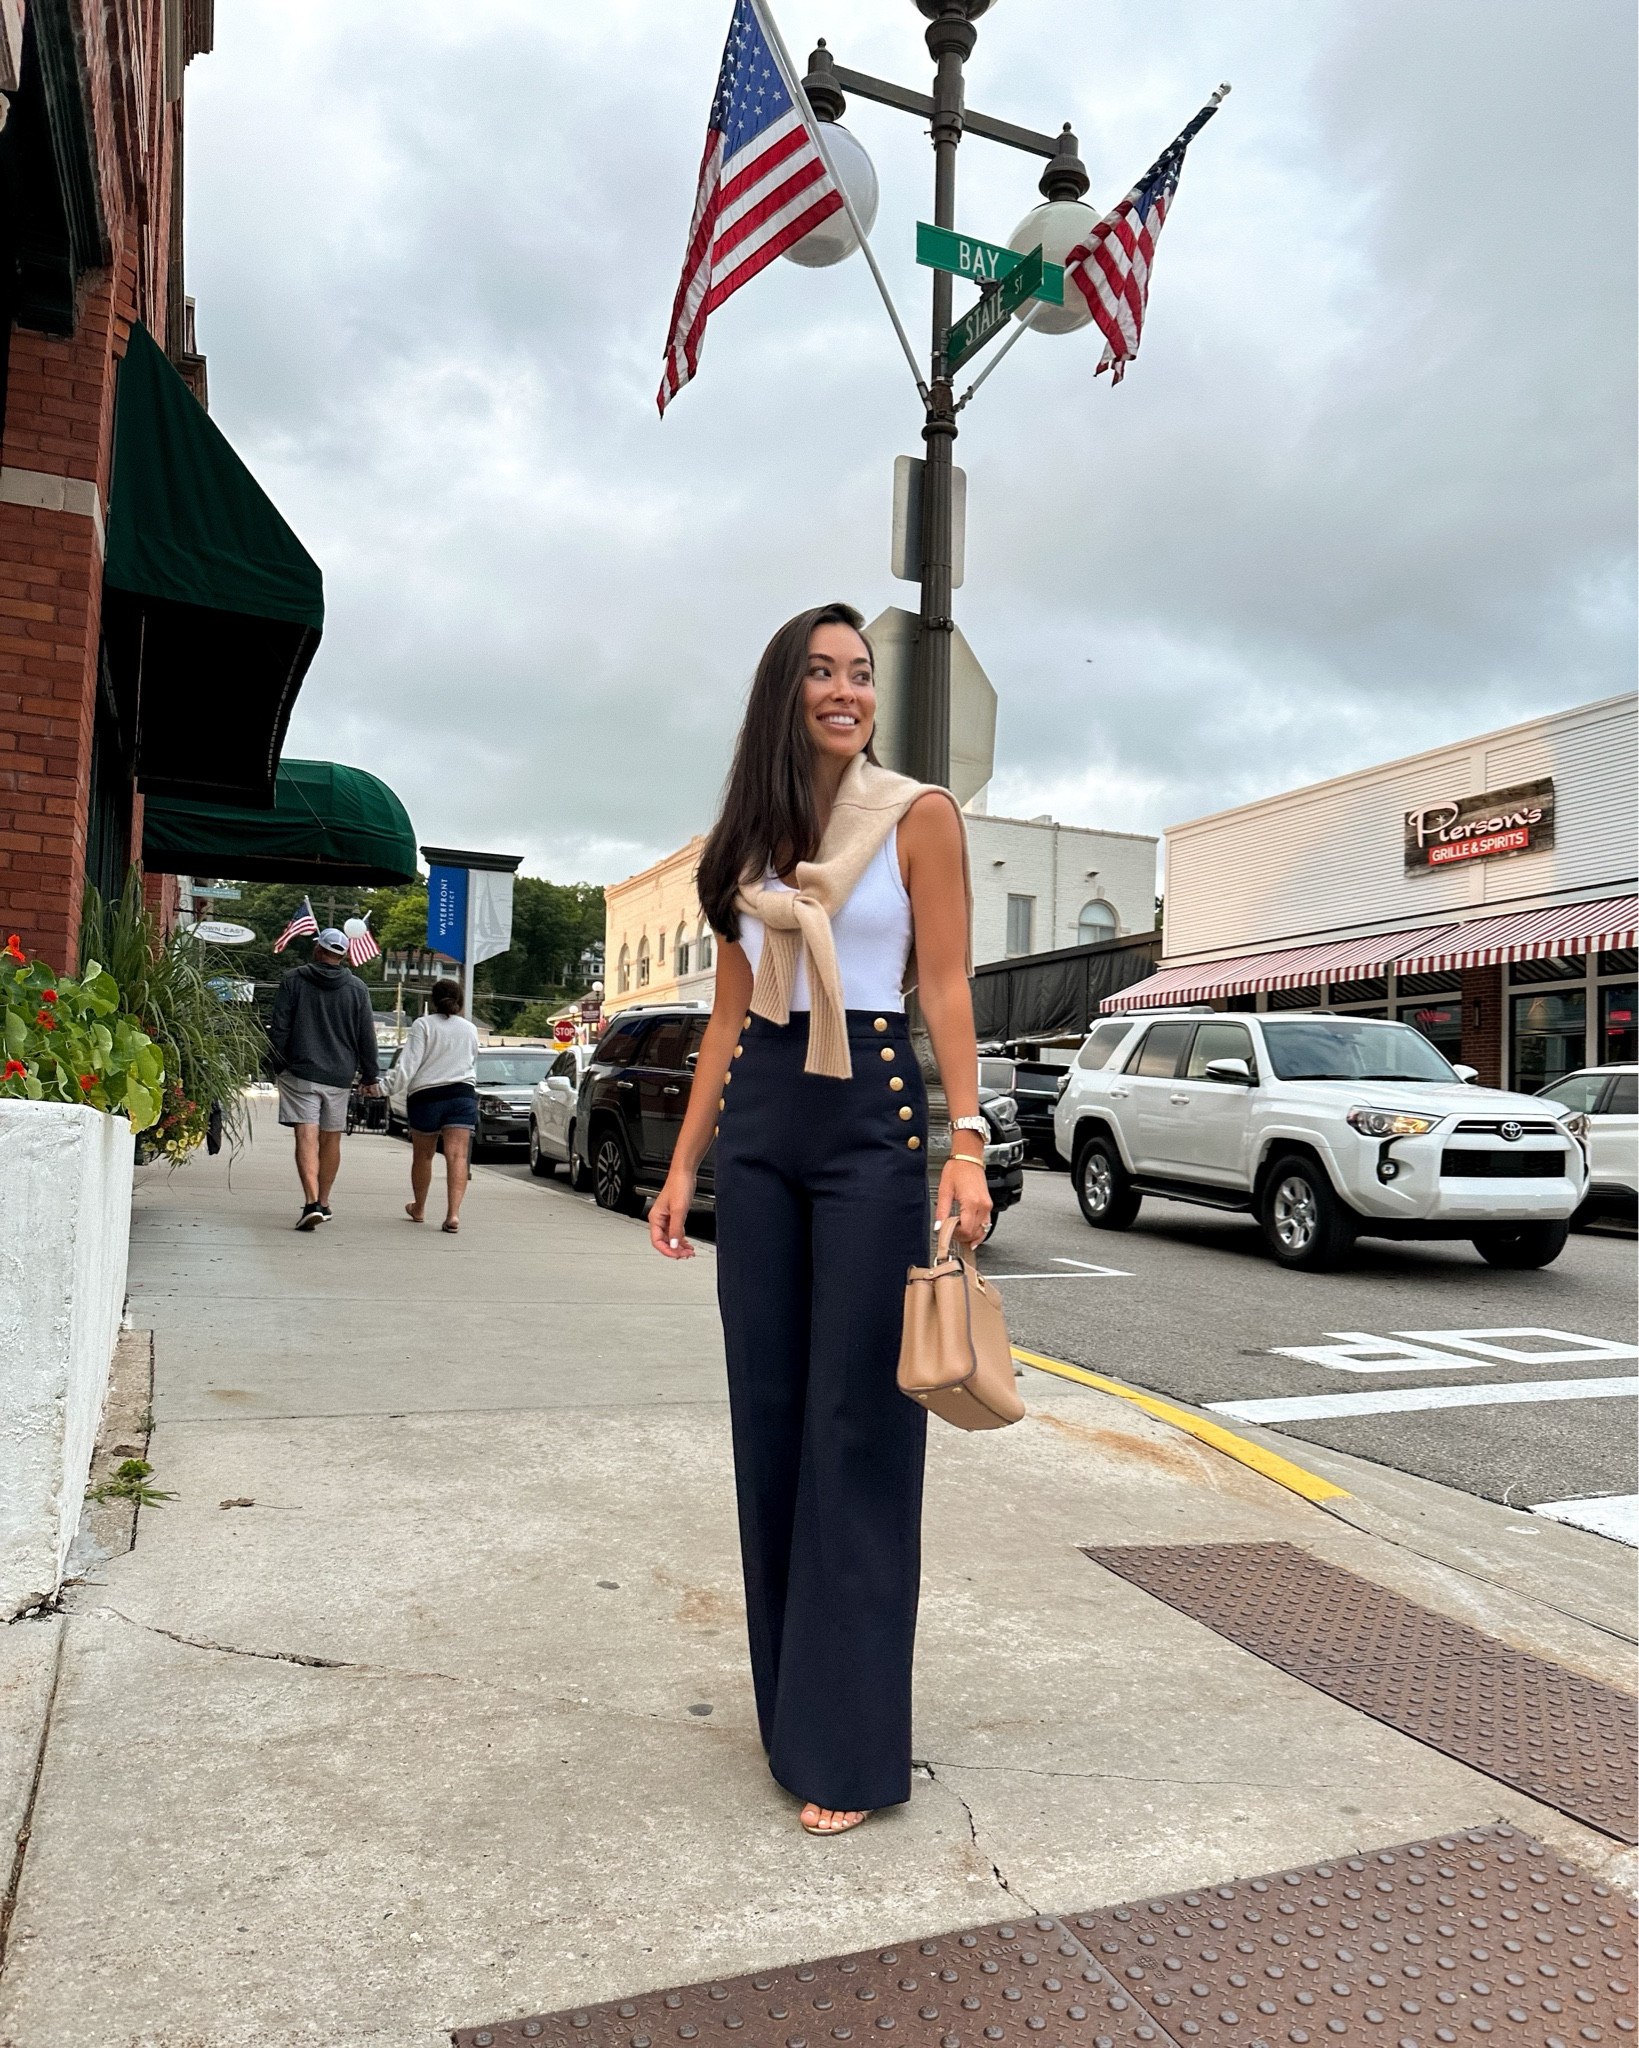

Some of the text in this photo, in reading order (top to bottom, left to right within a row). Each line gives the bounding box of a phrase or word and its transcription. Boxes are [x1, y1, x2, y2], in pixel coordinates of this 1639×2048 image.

[959, 240, 1000, 278] BAY
[965, 274, 1024, 346] STATE ST
[1408, 800, 1542, 848] Pierson's
[1431, 831, 1524, 862] GRILLE & SPIRITS
[439, 878, 449, 936] WATERFRONT
[447, 890, 456, 926] DISTRICT
[555, 1027, 575, 1037] STOP
